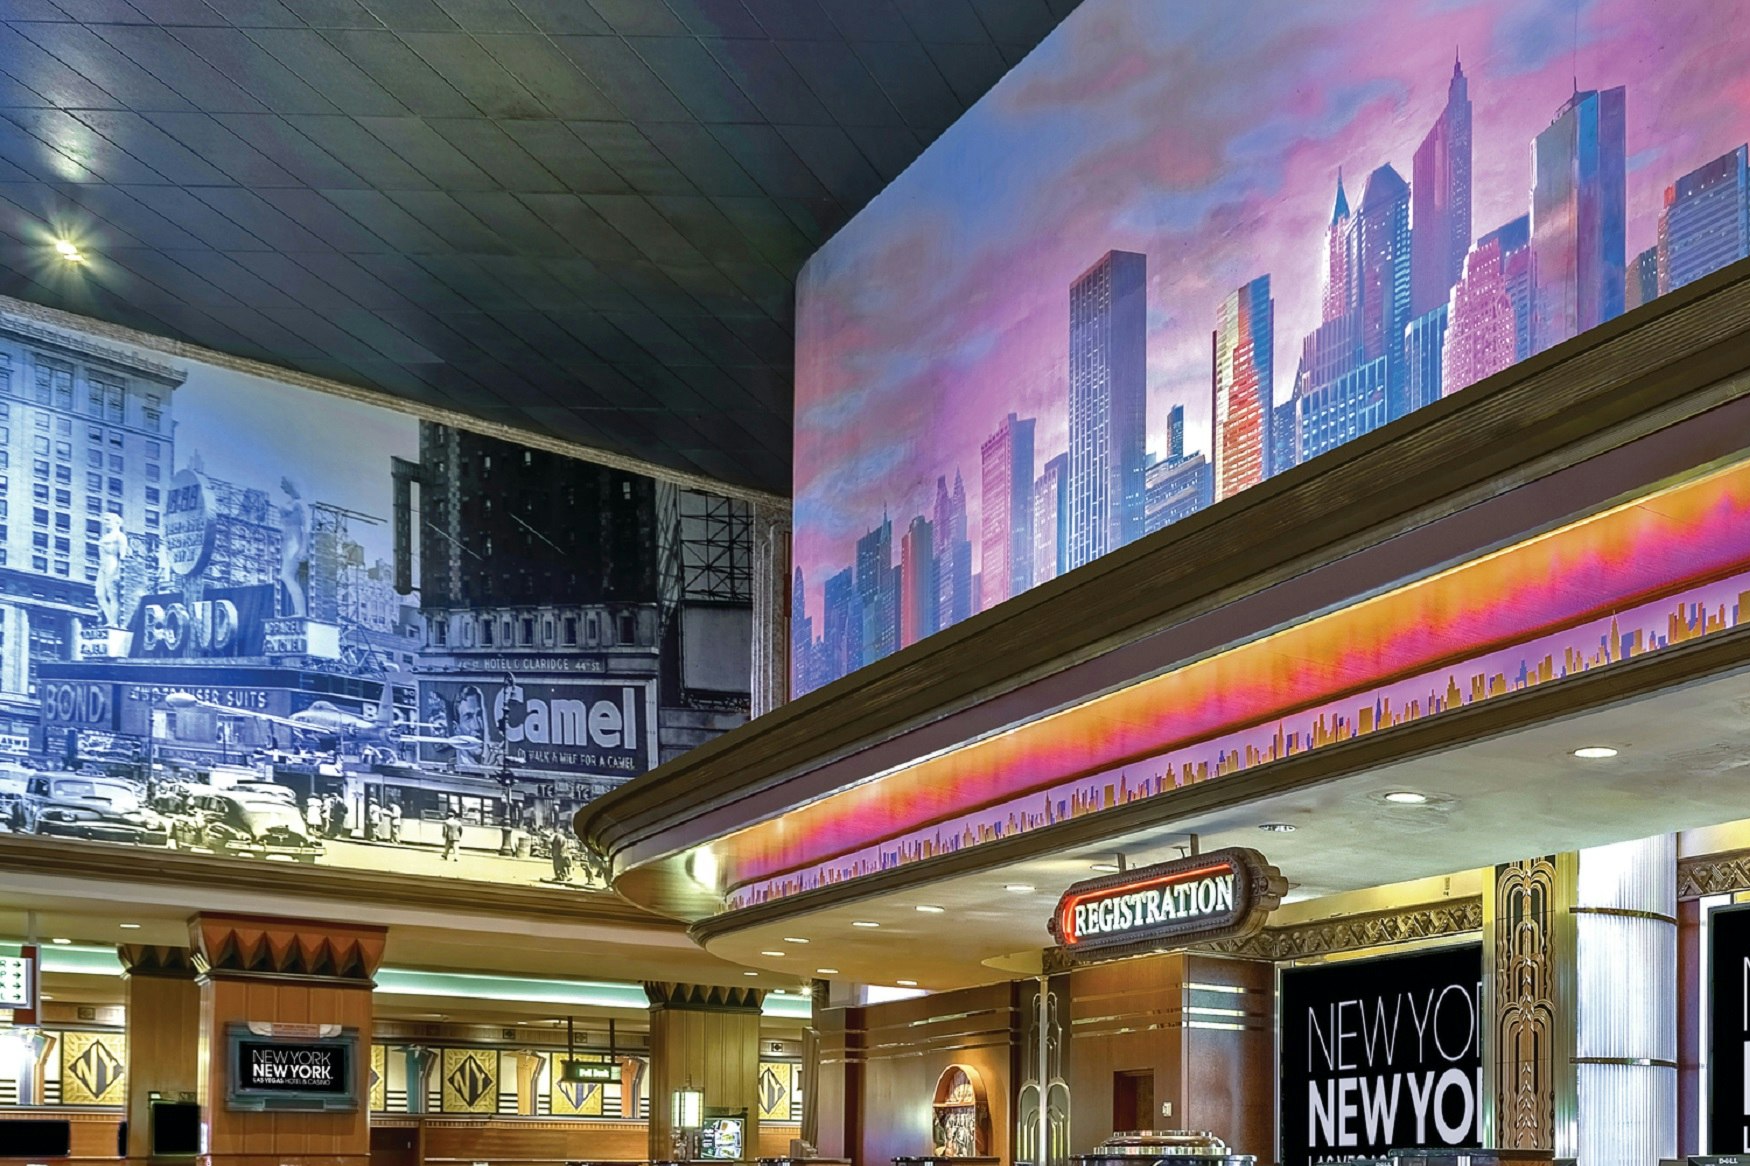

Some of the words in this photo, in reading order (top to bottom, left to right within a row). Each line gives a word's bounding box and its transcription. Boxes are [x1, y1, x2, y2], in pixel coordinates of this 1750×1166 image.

[484, 658, 511, 669] HOTEL
[523, 658, 569, 670] CLARIDGE
[46, 684, 107, 722] BOND
[227, 690, 267, 708] SUITS
[494, 685, 637, 749] Camel
[580, 754, 597, 766] FOR
[600, 756, 606, 767] A
[1074, 873, 1235, 937] REGISTRATION
[1308, 993, 1401, 1073] NEW
[253, 1050, 288, 1064] NEW
[290, 1050, 331, 1066] YORK
[253, 1064, 288, 1078] NEW
[1308, 1073, 1401, 1147] NEW
[1407, 1067, 1483, 1145] YO
